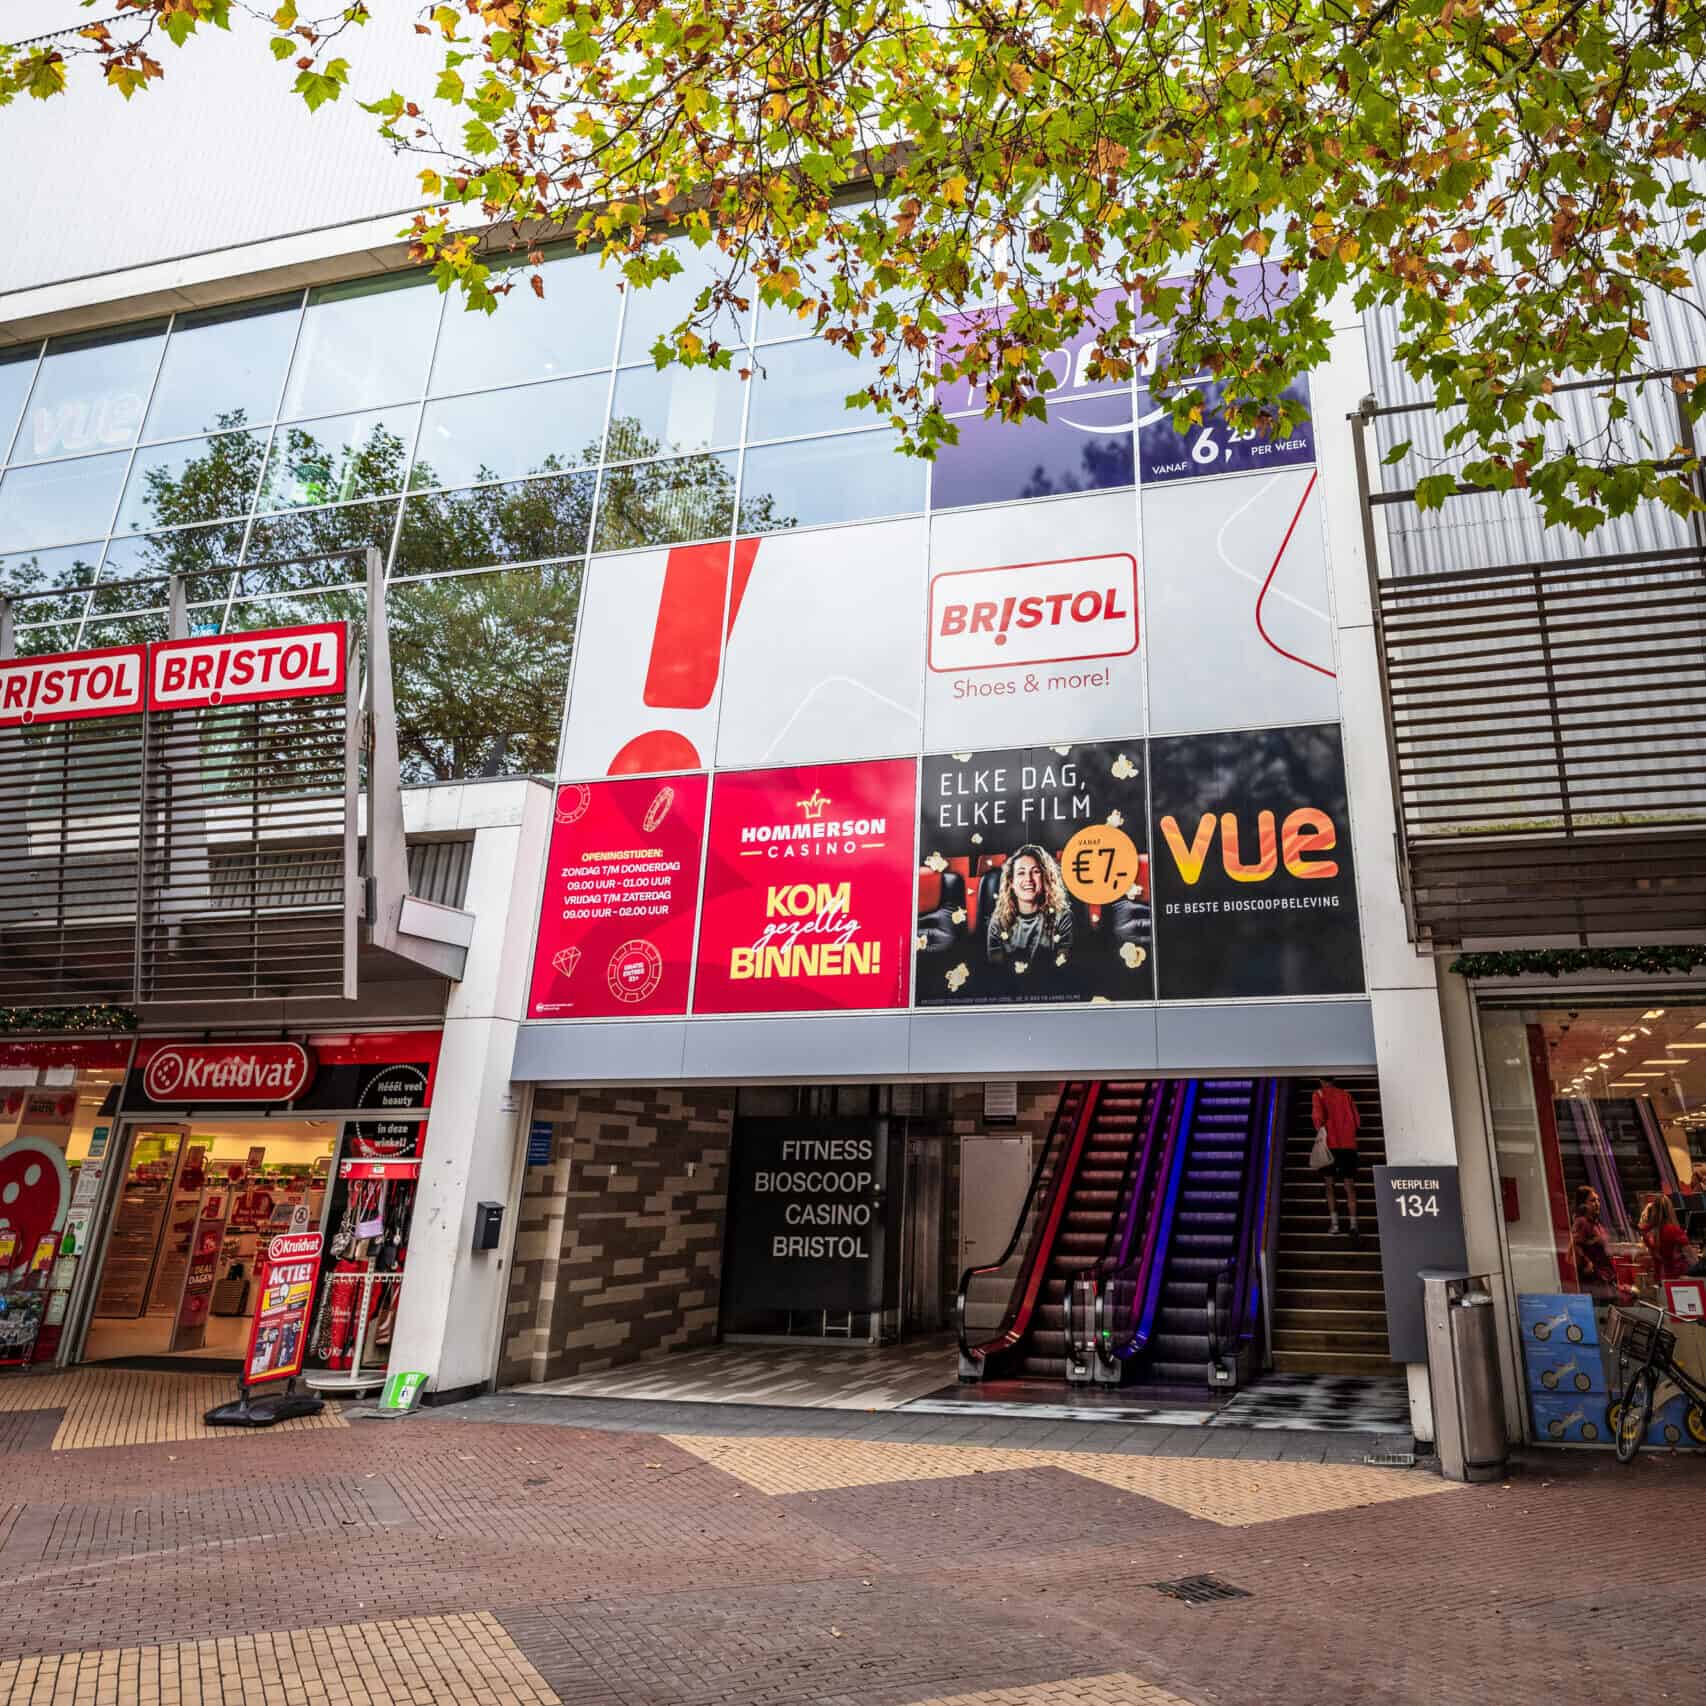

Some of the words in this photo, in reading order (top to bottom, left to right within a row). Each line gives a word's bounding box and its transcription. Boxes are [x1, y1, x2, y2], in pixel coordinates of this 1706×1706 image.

[1152, 461, 1188, 475] VANAF
[1251, 445, 1272, 457] PER
[1275, 439, 1307, 454] WEEK
[953, 678, 1016, 699] Shoes
[1023, 673, 1040, 692] &
[1048, 667, 1111, 691] more!
[940, 769, 1007, 796] ELKE
[1022, 764, 1085, 790] DAG,
[939, 800, 1006, 827] ELKE
[1021, 794, 1090, 822] FILM
[741, 818, 886, 843] HOMMERSON
[767, 841, 856, 858] CASINO
[561, 866, 601, 877] ZONDAG
[602, 865, 620, 876] T/M
[621, 862, 681, 873] DONDERDAG
[1072, 848, 1127, 890] €7,-
[567, 881, 594, 890] 09.00
[595, 880, 616, 889] UUR
[623, 878, 649, 888] 01.00
[650, 876, 671, 886] UUR
[603, 893, 621, 904] T/M
[622, 891, 671, 901] ZATERDAG
[766, 882, 851, 917] KOM
[1166, 904, 1180, 914] DE
[1184, 902, 1219, 914] BESTE
[1223, 896, 1340, 912] BIOSCOOPBELEVING
[563, 909, 590, 919] 09.00
[591, 908, 612, 918] UUR
[619, 906, 647, 916] 02.00
[648, 905, 669, 915] UUR
[752, 897, 861, 955] gezellig
[729, 941, 881, 980] BINNEN!
[184, 1056, 296, 1088] Kruidvat
[382, 1095, 413, 1107] beauty
[377, 1123, 386, 1134] in
[387, 1123, 409, 1134] deze
[783, 1140, 872, 1160] FITNESS
[755, 1172, 871, 1192] BIOSCOOP
[1391, 1179, 1440, 1190] VEERPLEIN
[785, 1203, 870, 1225] CASINO
[1395, 1195, 1440, 1217] 134
[283, 1238, 319, 1254] Kruidvat
[773, 1236, 869, 1258] BRISTOL
